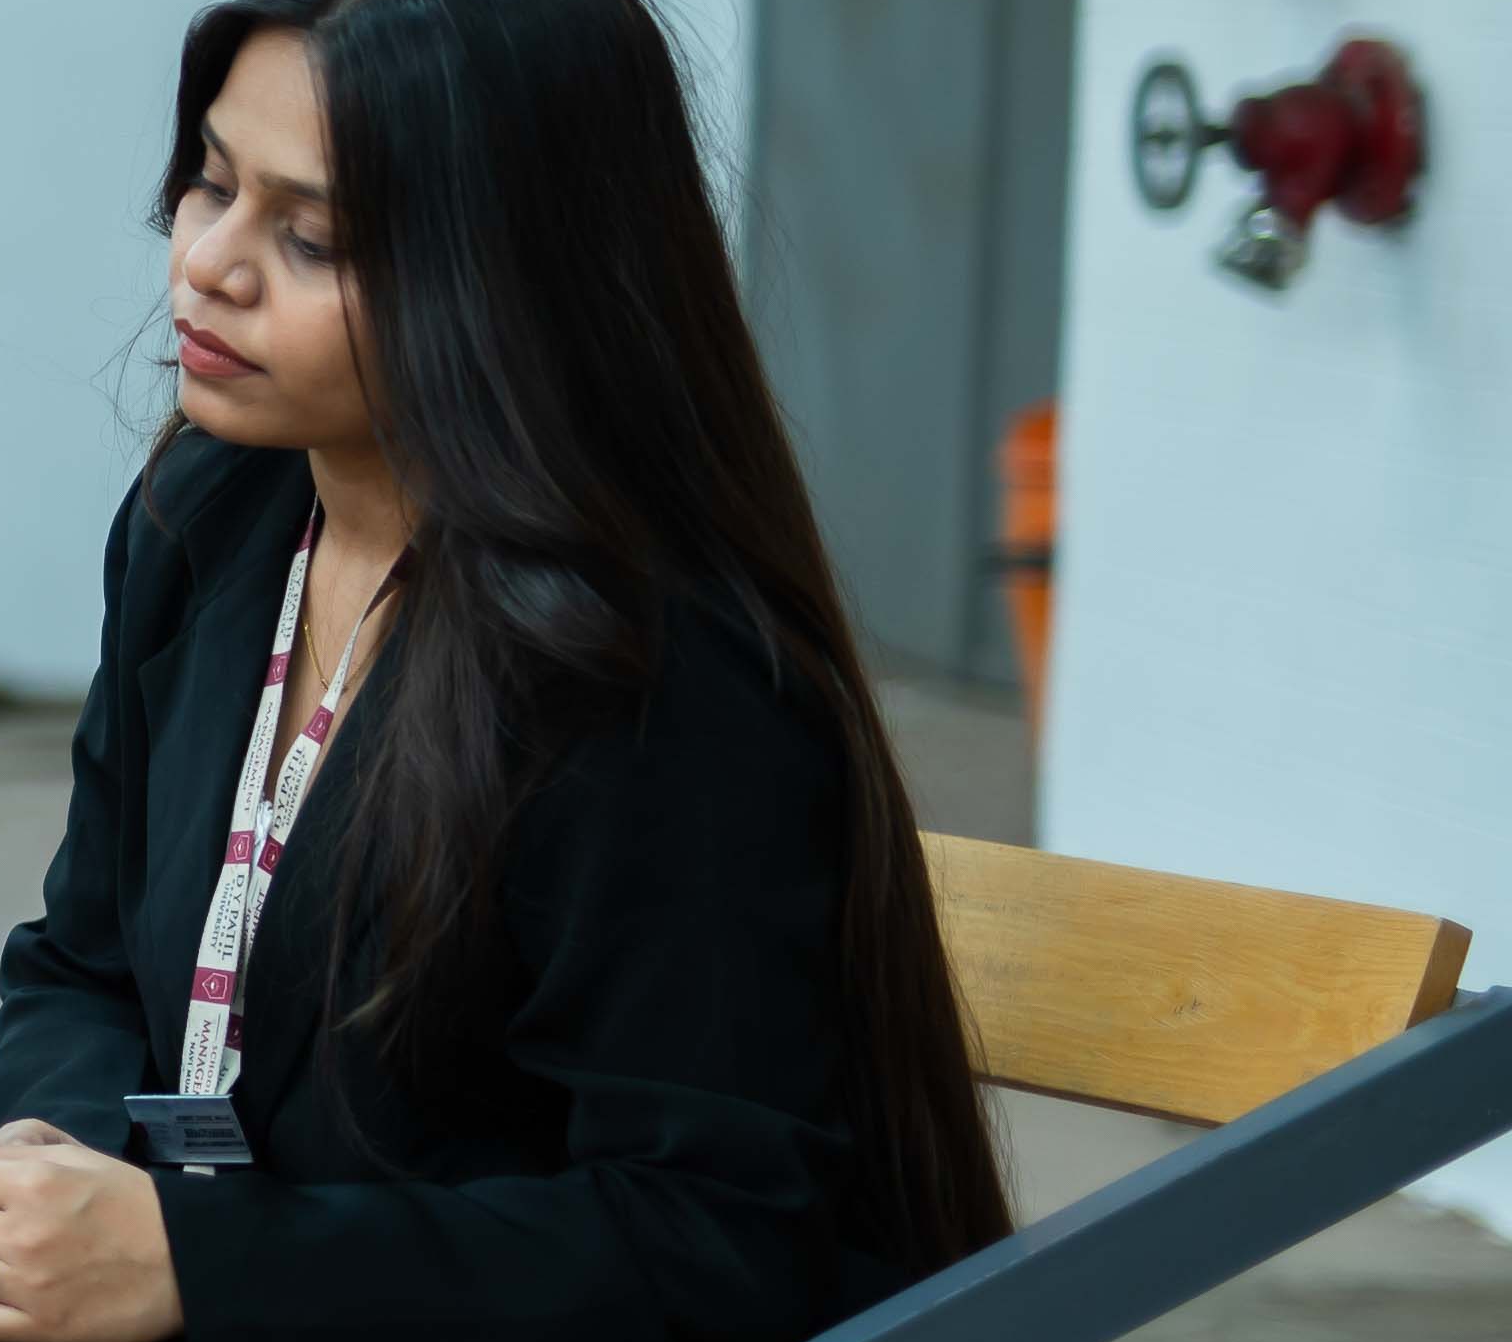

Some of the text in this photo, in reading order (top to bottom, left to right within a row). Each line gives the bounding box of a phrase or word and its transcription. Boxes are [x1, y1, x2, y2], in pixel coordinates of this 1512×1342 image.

[237, 874, 244, 887] D
[233, 893, 242, 903] Y
[210, 883, 230, 949] UNIVERSITY
[222, 910, 239, 960] PATIL
